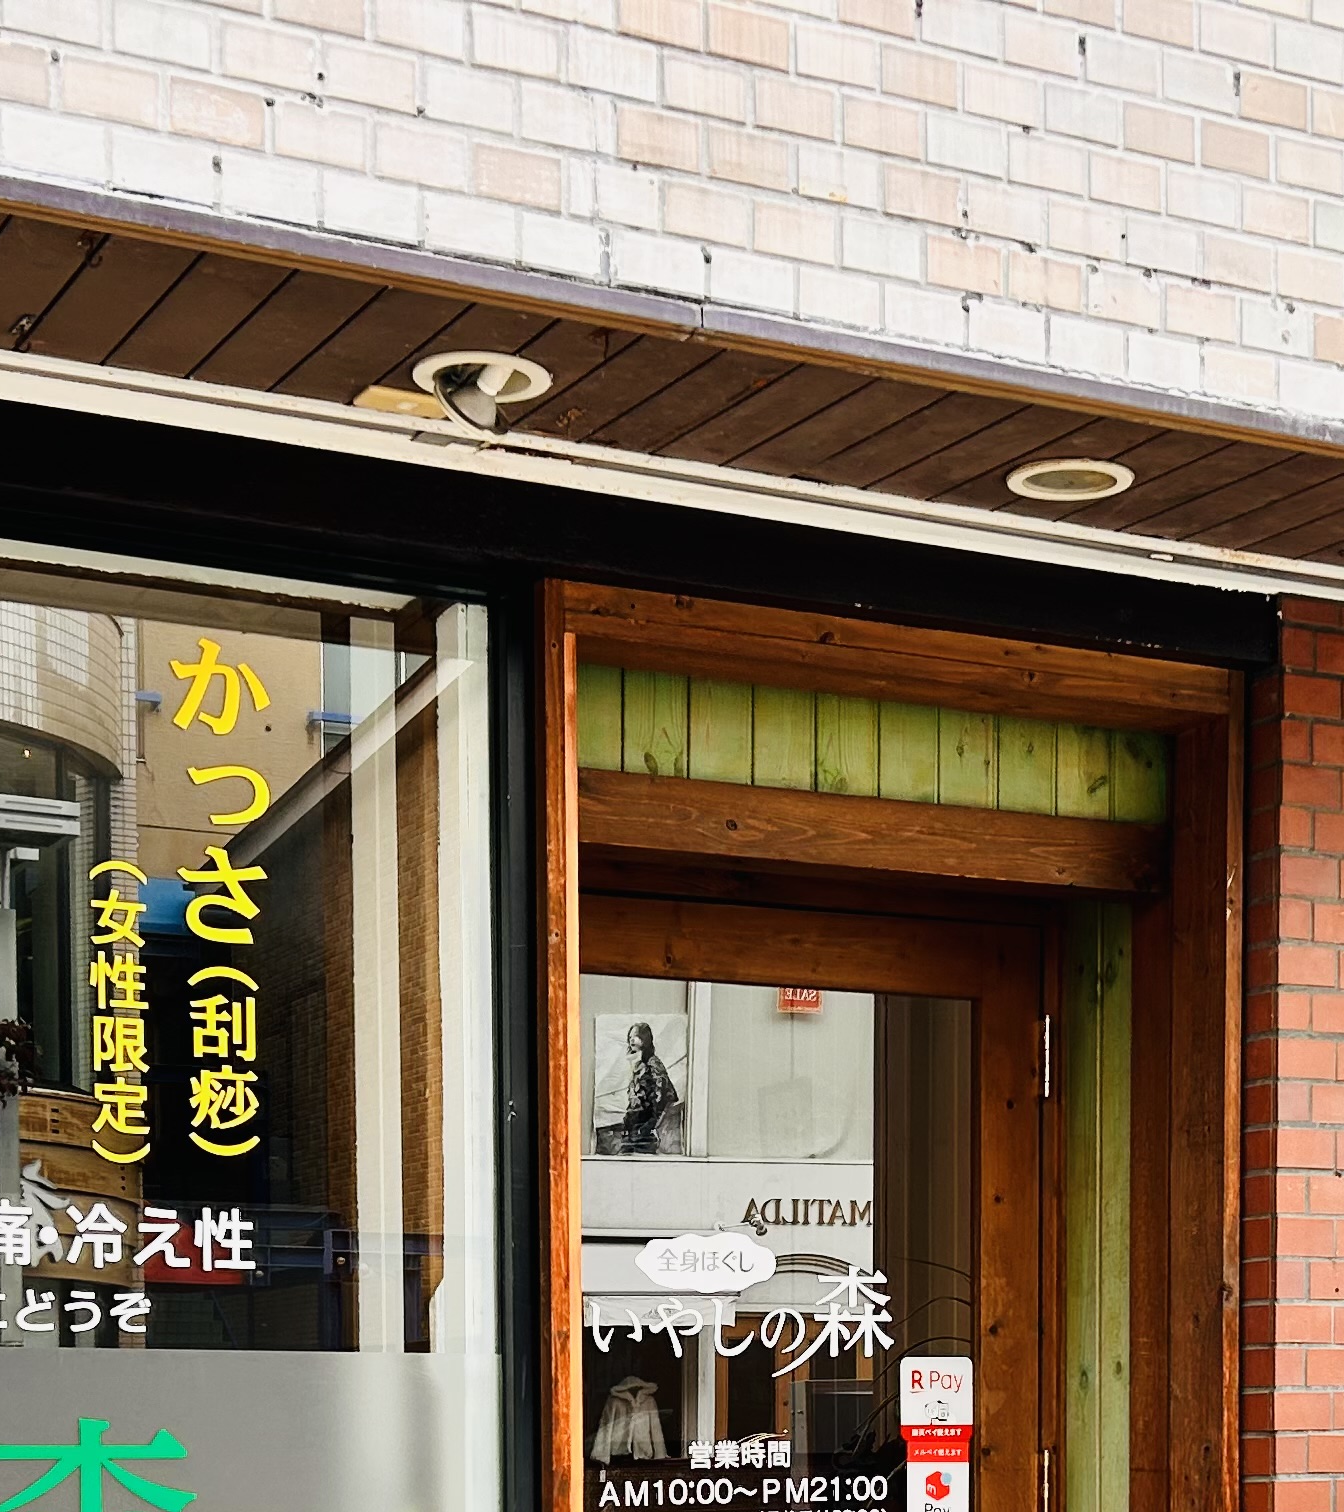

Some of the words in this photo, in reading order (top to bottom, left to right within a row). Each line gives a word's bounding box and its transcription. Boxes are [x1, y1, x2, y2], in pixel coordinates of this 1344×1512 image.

[88, 860, 151, 1164] (女性限定)
[657, 1248, 755, 1273] 全身ほぐし
[590, 1265, 895, 1378] いやしの森
[929, 1370, 964, 1393] Pay
[688, 1440, 791, 1470] 営業時間
